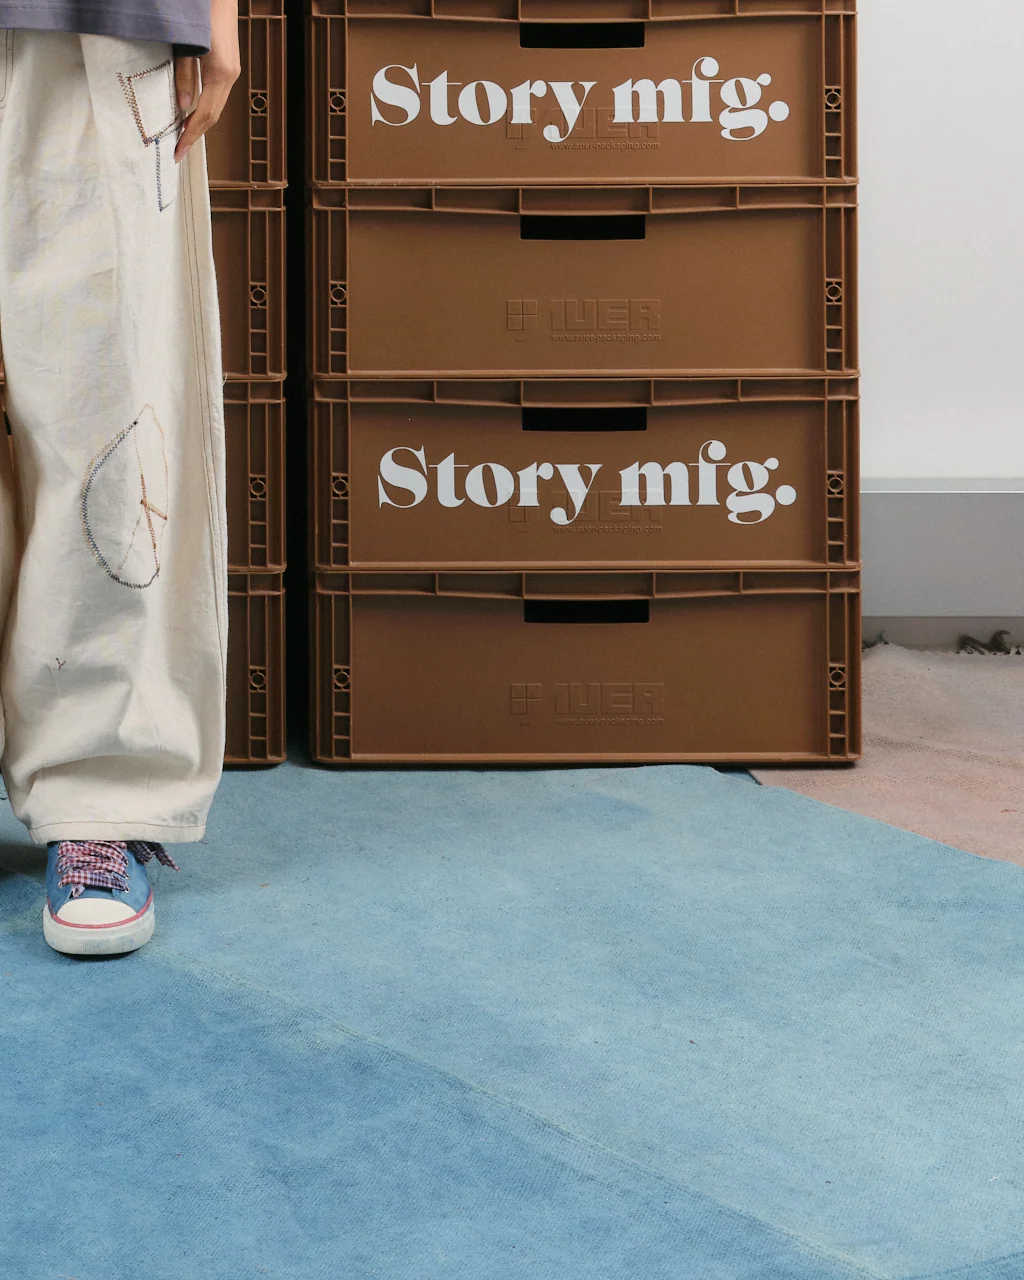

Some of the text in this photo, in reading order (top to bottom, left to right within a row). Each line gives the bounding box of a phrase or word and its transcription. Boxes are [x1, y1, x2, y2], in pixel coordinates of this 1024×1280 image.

[370, 56, 790, 143] Story mfg.
[377, 439, 797, 525] Story mfg.
